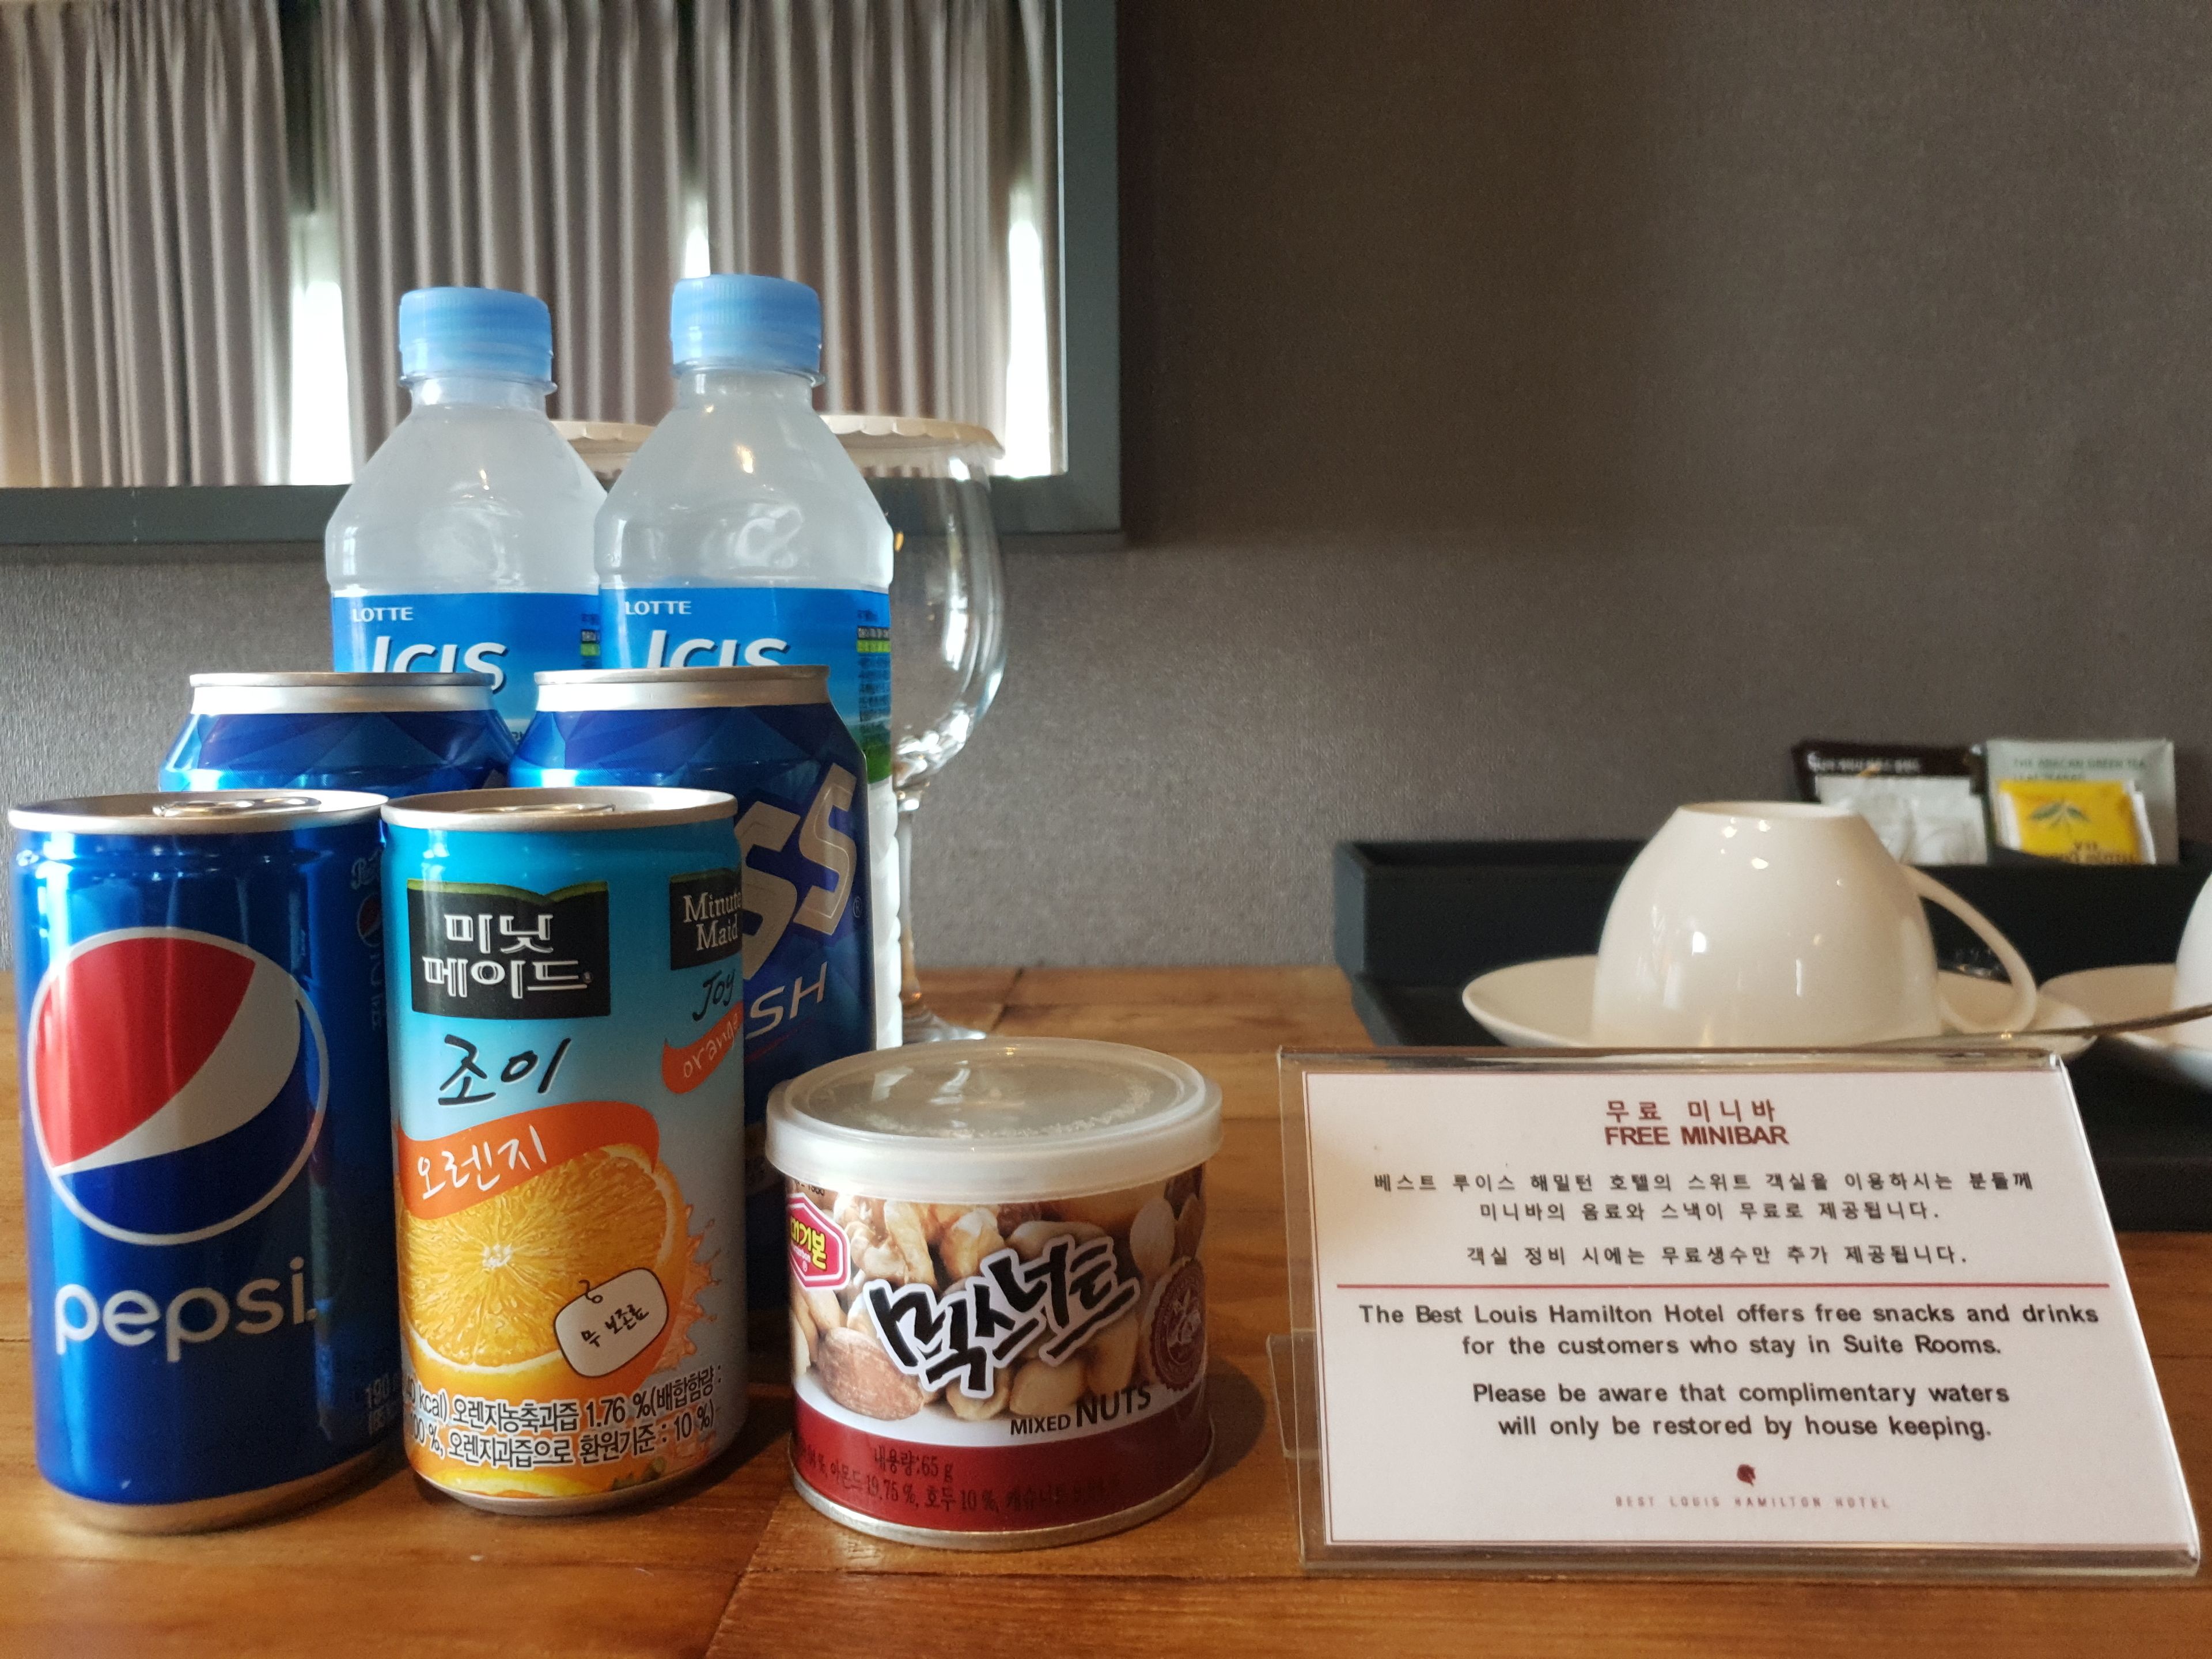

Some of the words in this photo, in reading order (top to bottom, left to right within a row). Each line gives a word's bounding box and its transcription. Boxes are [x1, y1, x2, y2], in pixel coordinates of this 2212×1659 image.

[352, 606, 414, 623] LOTTE
[625, 600, 692, 615] LOTTE
[444, 913, 554, 954] 미닛
[695, 913, 738, 951] Maid
[422, 956, 589, 999] 메이드
[692, 969, 736, 1022] Joy
[437, 1034, 572, 1106] 조이
[1605, 1100, 1662, 1124] 무료
[1687, 1098, 1776, 1124] 미니바
[1604, 1125, 1671, 1146] FREE
[1680, 1124, 1790, 1146] MINIBAR
[416, 1124, 547, 1200] 오렌지
[1373, 1173, 1437, 1194] 베스트
[1452, 1173, 1516, 1193] 루이스
[1529, 1173, 1593, 1193] 해밀턴
[1609, 1173, 1672, 1193] 호텔의
[1688, 1173, 1751, 1192] 스위트
[1765, 1172, 1828, 1192] 객실을
[1843, 1172, 1953, 1192] 이용하시는
[1968, 1171, 2034, 1191] 분들께
[1479, 1202, 1566, 1222] 미니바의
[1581, 1202, 1645, 1222] 음료와
[1661, 1202, 1724, 1221] 스낵이
[1739, 1201, 1804, 1221] 무료로
[1817, 1200, 1940, 1221] 제공됩니다.
[1467, 1246, 1508, 1267] 객실
[1524, 1246, 1566, 1267] 정비
[1581, 1246, 1645, 1266] 시에는
[1661, 1245, 1771, 1266] 무료생수만
[1787, 1244, 1828, 1265] 추가
[1843, 1244, 1967, 1266] 제공됩니다.
[54, 1256, 307, 1363] pepsi
[1358, 1304, 1404, 1324] The
[1415, 1304, 1463, 1324] Best
[1474, 1304, 1538, 1324] Louis
[1548, 1304, 1653, 1324] Hamilton
[1663, 1303, 1725, 1324] Hotel
[1736, 1302, 1806, 1323] offers
[1814, 1302, 1862, 1323] free
[1872, 1302, 1956, 1323] snacks
[1965, 1302, 2011, 1324] and
[2021, 1302, 2100, 1324] drinks
[580, 1330, 601, 1348] 무
[1461, 1335, 1495, 1355] for
[1508, 1335, 1546, 1355] the
[1557, 1336, 1680, 1355] customers
[1689, 1334, 1738, 1355] who
[1748, 1335, 1796, 1359] stay
[1807, 1334, 1831, 1354] in
[1842, 1333, 1904, 1355] Suite
[1914, 1333, 2002, 1355] Rooms.
[1472, 1382, 1547, 1403] Please
[1557, 1382, 1587, 1403] be
[1598, 1387, 1668, 1403] aware
[1679, 1382, 1727, 1403] that
[1738, 1381, 1916, 1408] complimentary
[1927, 1383, 2011, 1404] waters
[452, 1397, 579, 1434] 오렌지농축과즙
[586, 1396, 626, 1427] 1.76
[1010, 1413, 1071, 1436] MIXED
[1075, 1387, 1152, 1428] NUTS
[1497, 1415, 1537, 1436] will
[1549, 1415, 1600, 1441] only
[1611, 1415, 1641, 1436] be
[1652, 1414, 1753, 1436] restored
[1763, 1414, 1793, 1441] by
[1804, 1414, 1878, 1436] house
[1887, 1414, 1992, 1442] keeping.
[448, 1431, 574, 1468] 오렌지과즙으로
